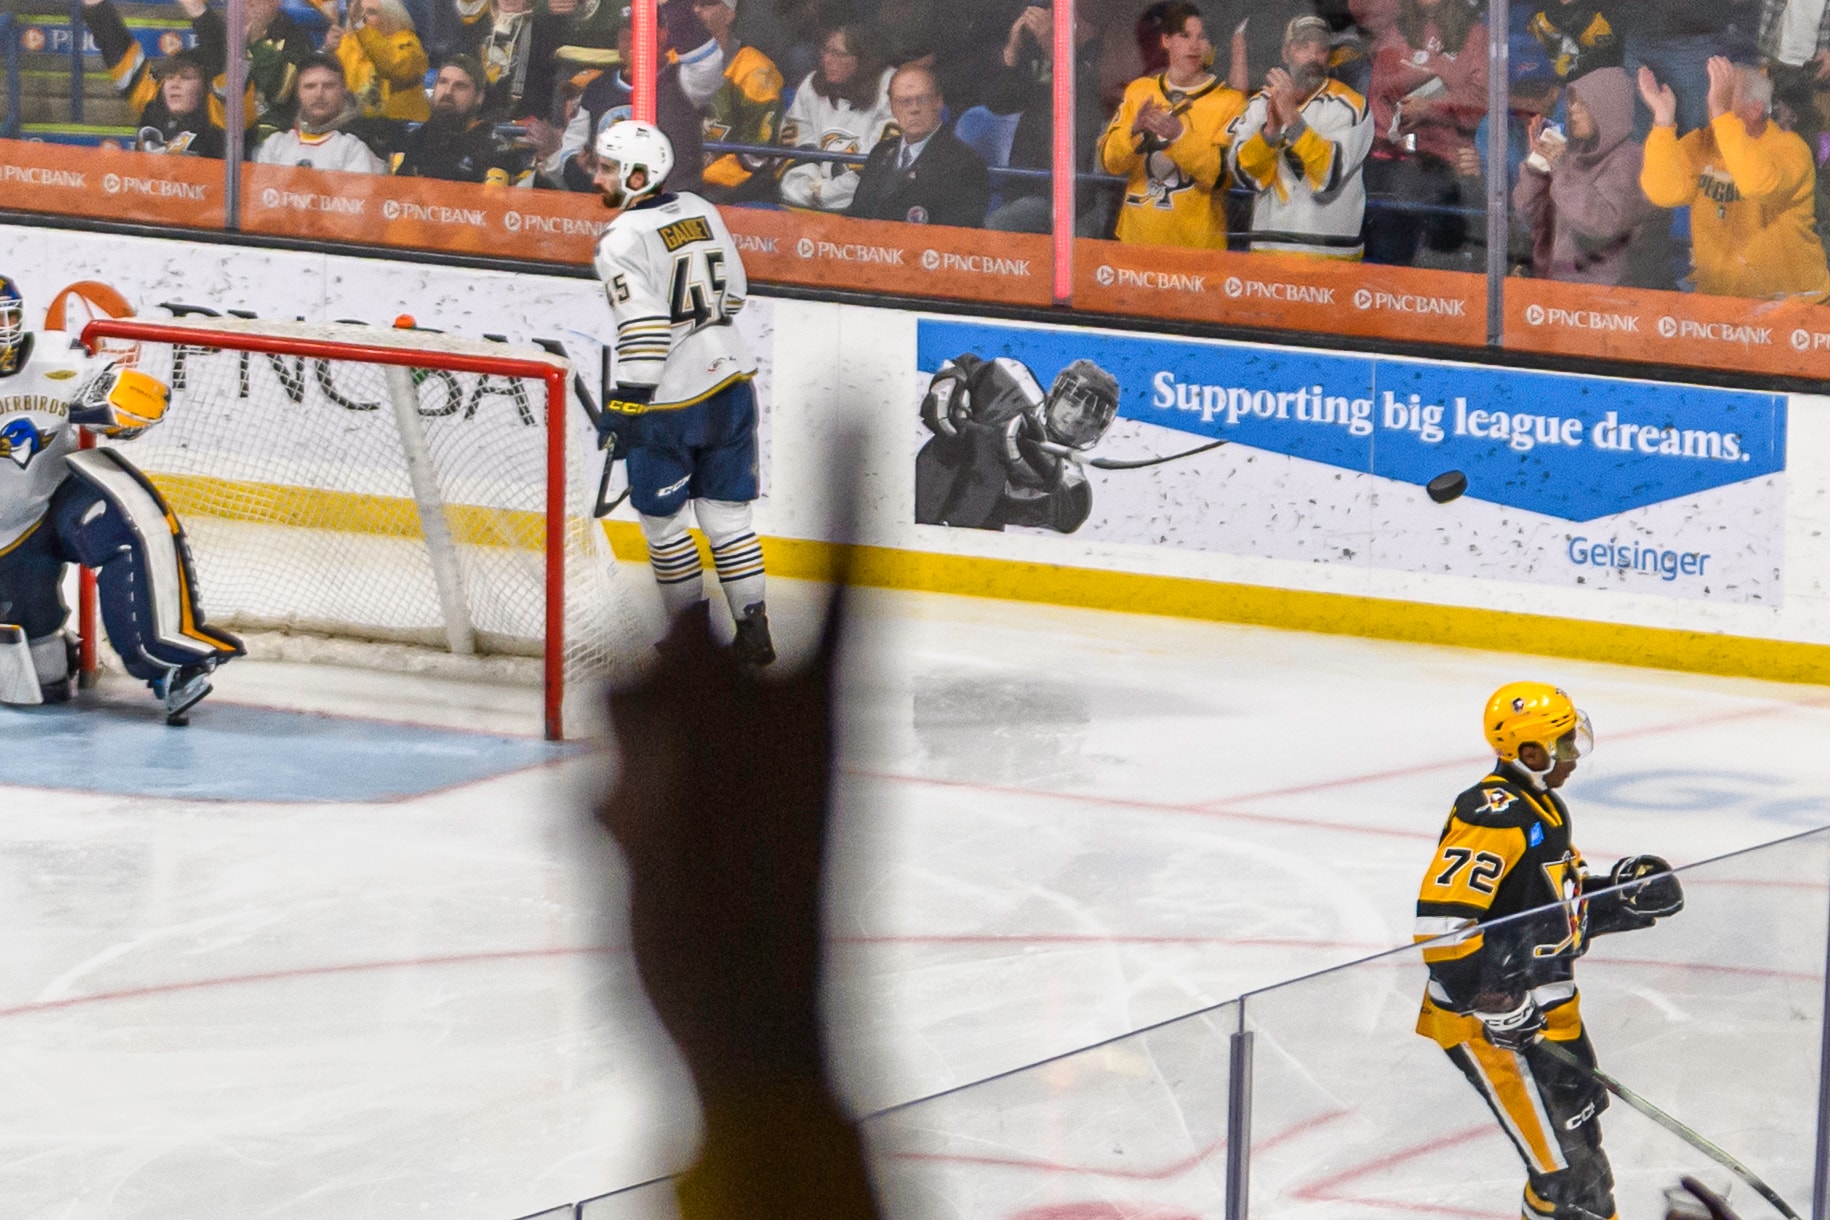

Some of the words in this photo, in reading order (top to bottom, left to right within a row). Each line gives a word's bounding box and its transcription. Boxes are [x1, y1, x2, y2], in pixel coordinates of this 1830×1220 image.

[668, 248, 727, 330] 45
[1153, 371, 1373, 437] Supporting
[1383, 391, 1445, 442] big
[1455, 397, 1584, 450] league
[1593, 411, 1751, 462] dreams.
[1568, 536, 1711, 582] Geisinger
[1434, 847, 1505, 894] 72
